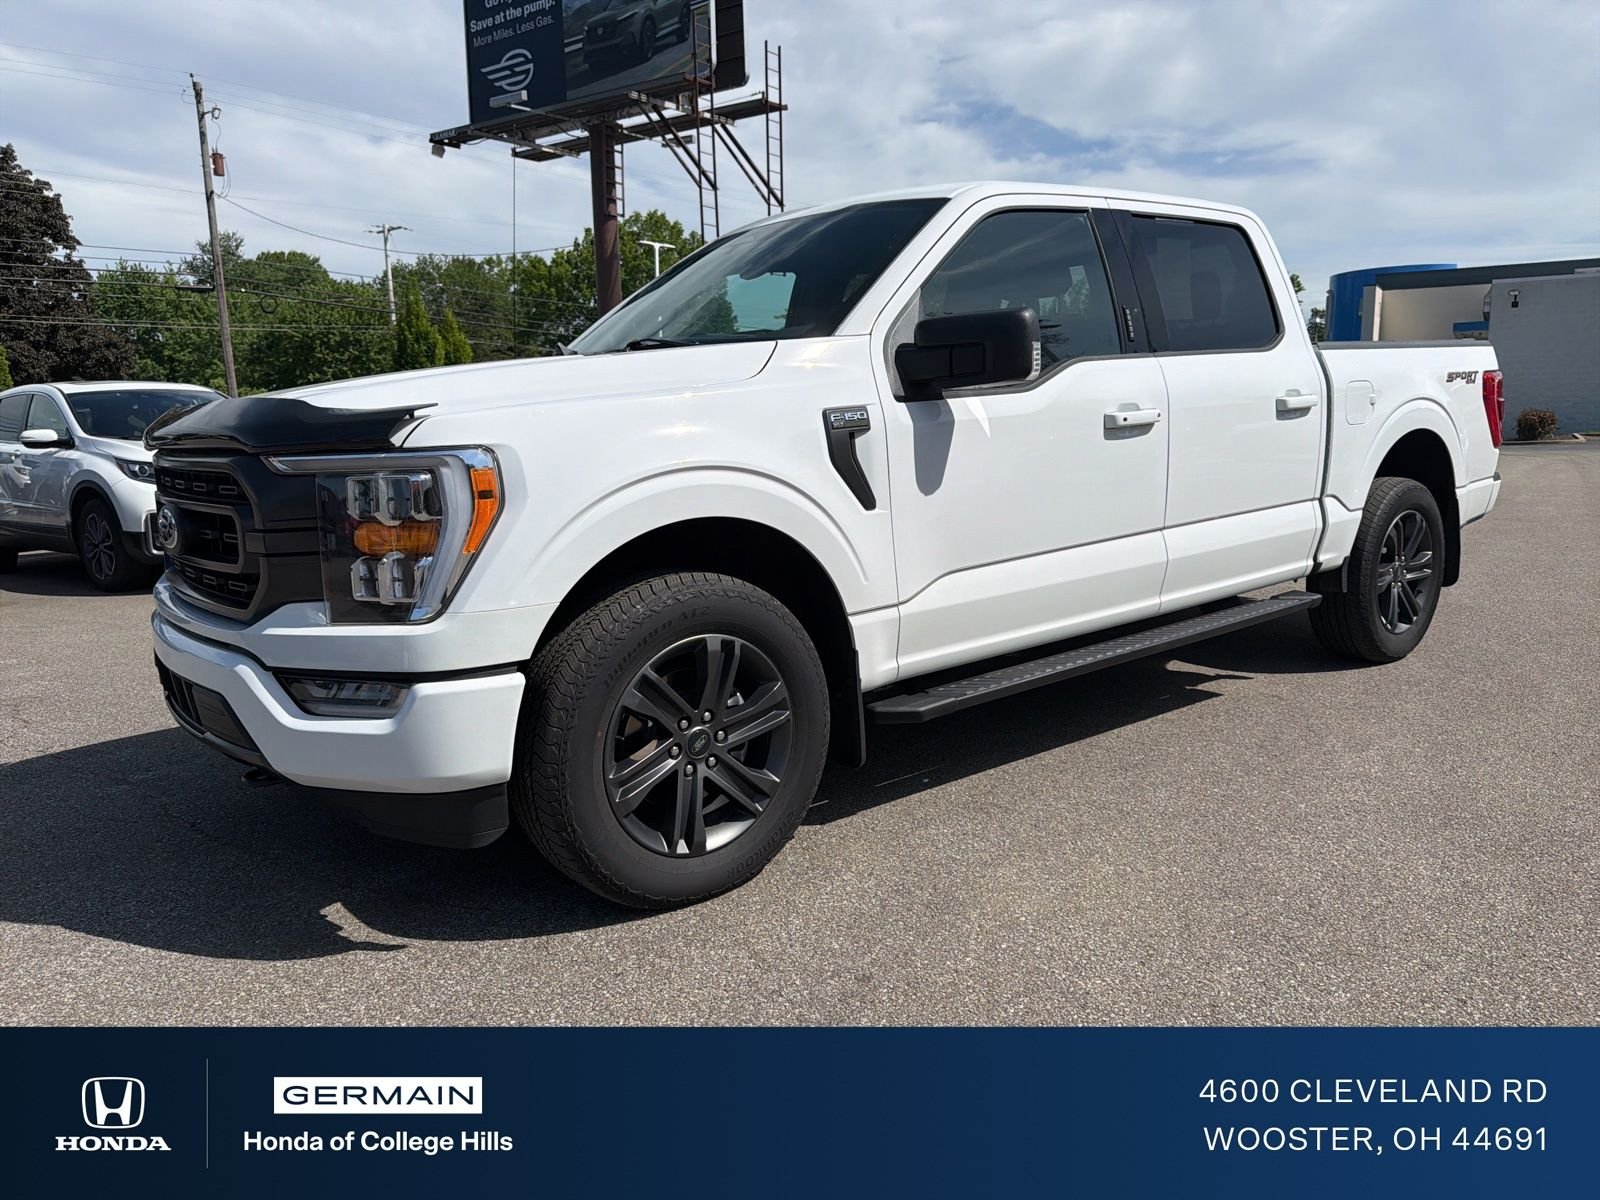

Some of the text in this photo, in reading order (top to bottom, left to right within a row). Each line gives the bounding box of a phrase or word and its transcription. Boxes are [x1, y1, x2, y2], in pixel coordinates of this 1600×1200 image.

[470, 0, 555, 32] Save at the pump.
[473, 15, 555, 48] More Miles. Less Gas.
[1446, 370, 1478, 382] SPORT
[831, 411, 867, 421] F-150
